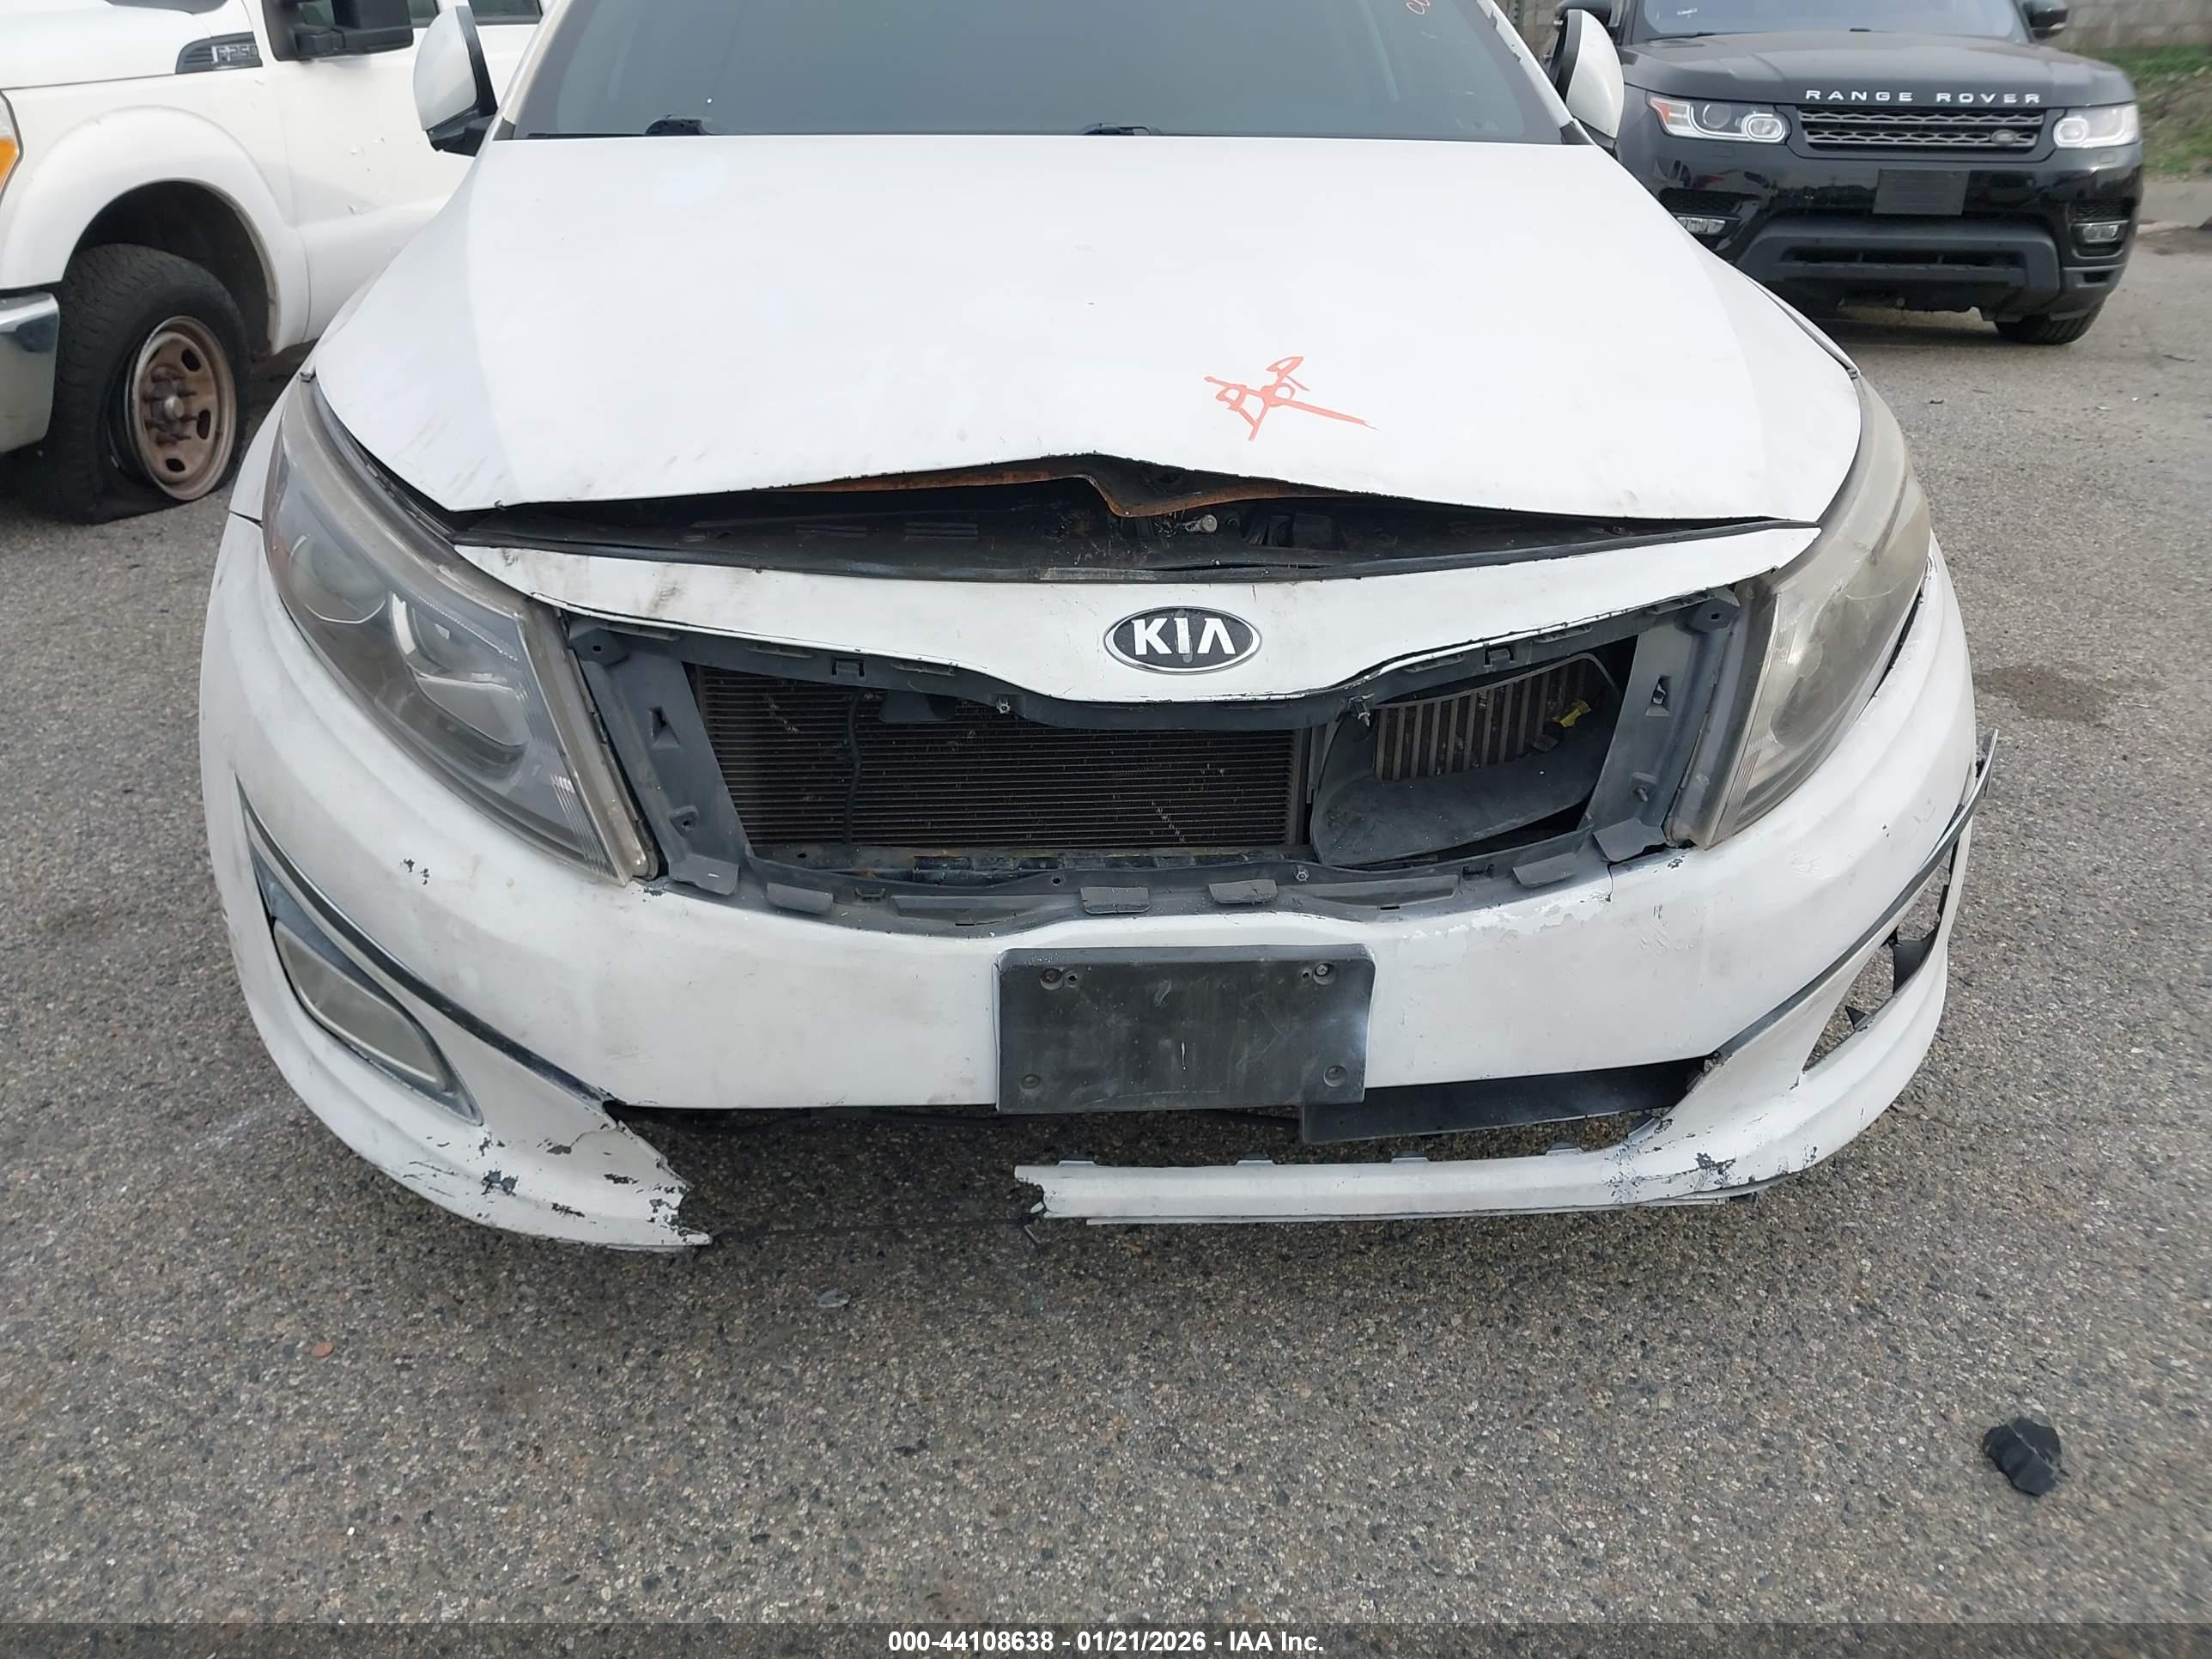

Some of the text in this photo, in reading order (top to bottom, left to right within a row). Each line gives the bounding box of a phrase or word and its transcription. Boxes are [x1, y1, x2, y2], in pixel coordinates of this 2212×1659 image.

[1805, 89, 2041, 104] RANGE ROVER
[1131, 617, 1237, 656] KIA
